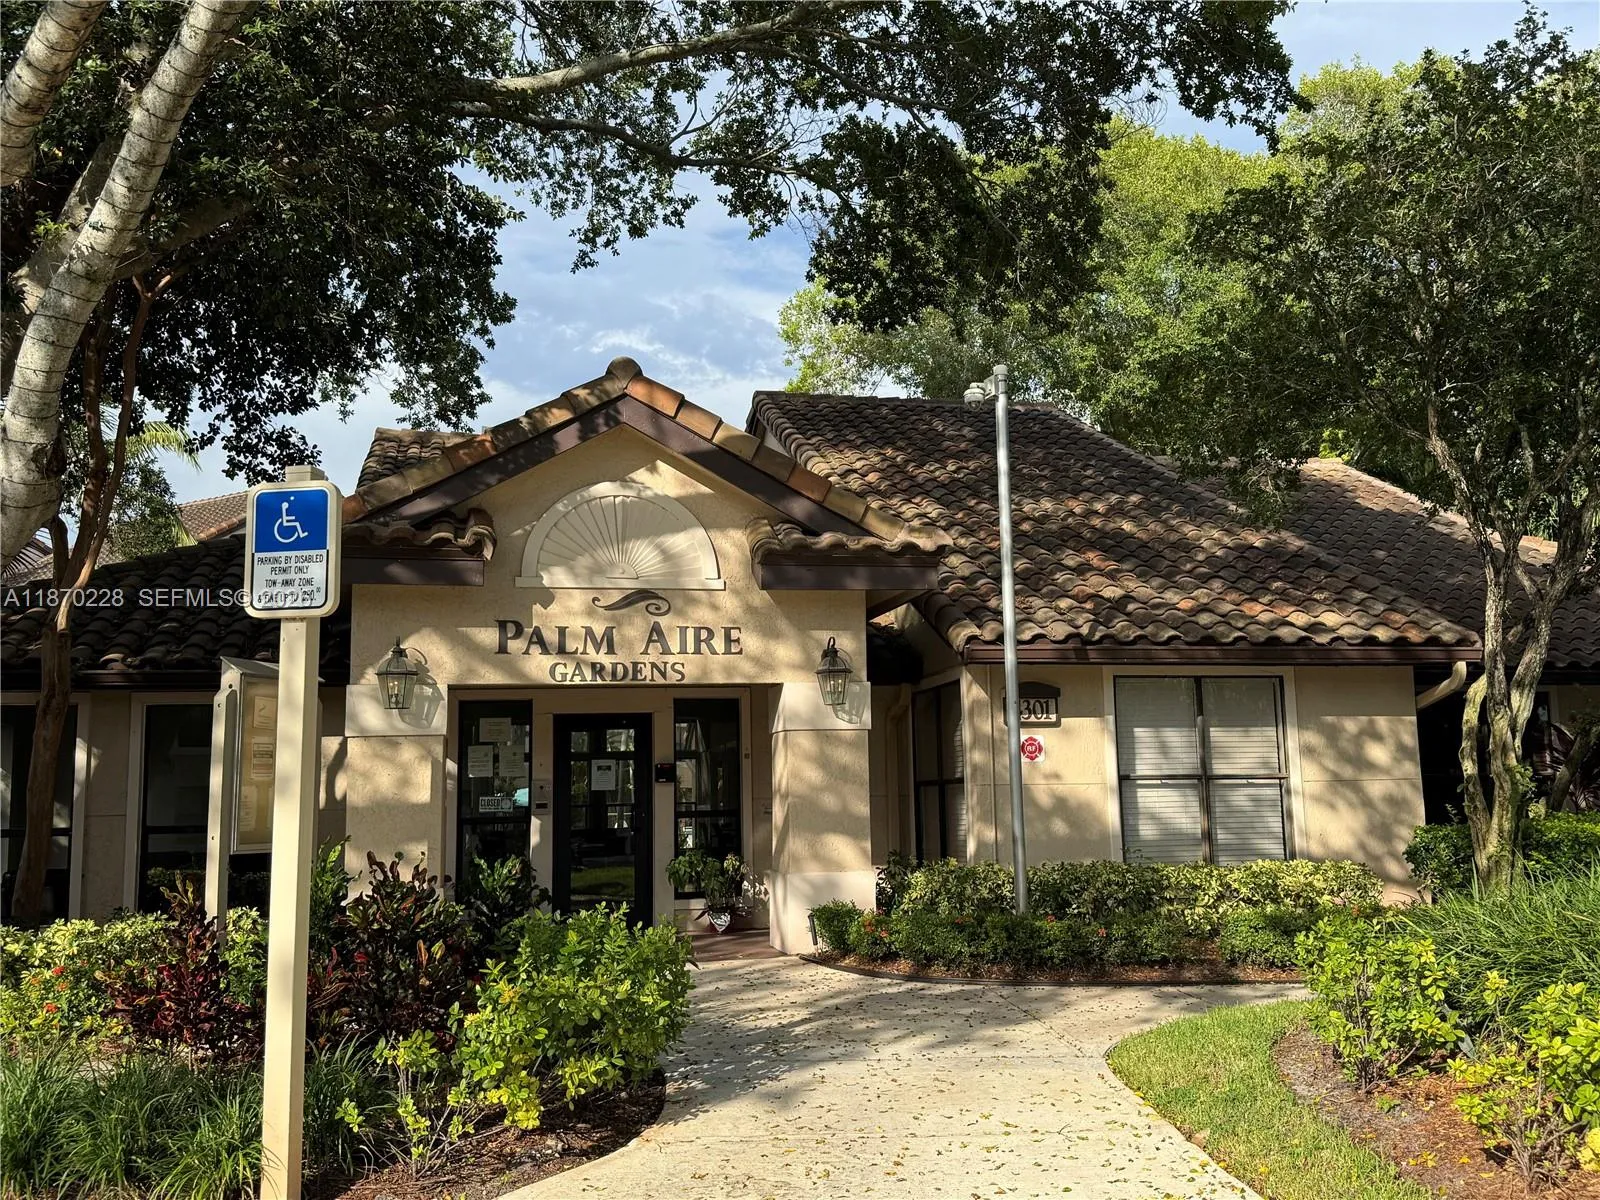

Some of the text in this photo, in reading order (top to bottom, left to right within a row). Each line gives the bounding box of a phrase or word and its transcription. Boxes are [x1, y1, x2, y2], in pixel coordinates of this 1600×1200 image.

[257, 554, 323, 565] PARKING BY DISABLED
[271, 565, 309, 575] PERMIT ONLY
[265, 577, 314, 588] TOW-AWAY ZONE
[494, 619, 744, 656] PALM AIRE
[549, 661, 686, 683] GARDENS
[480, 798, 501, 807] CLOSED
